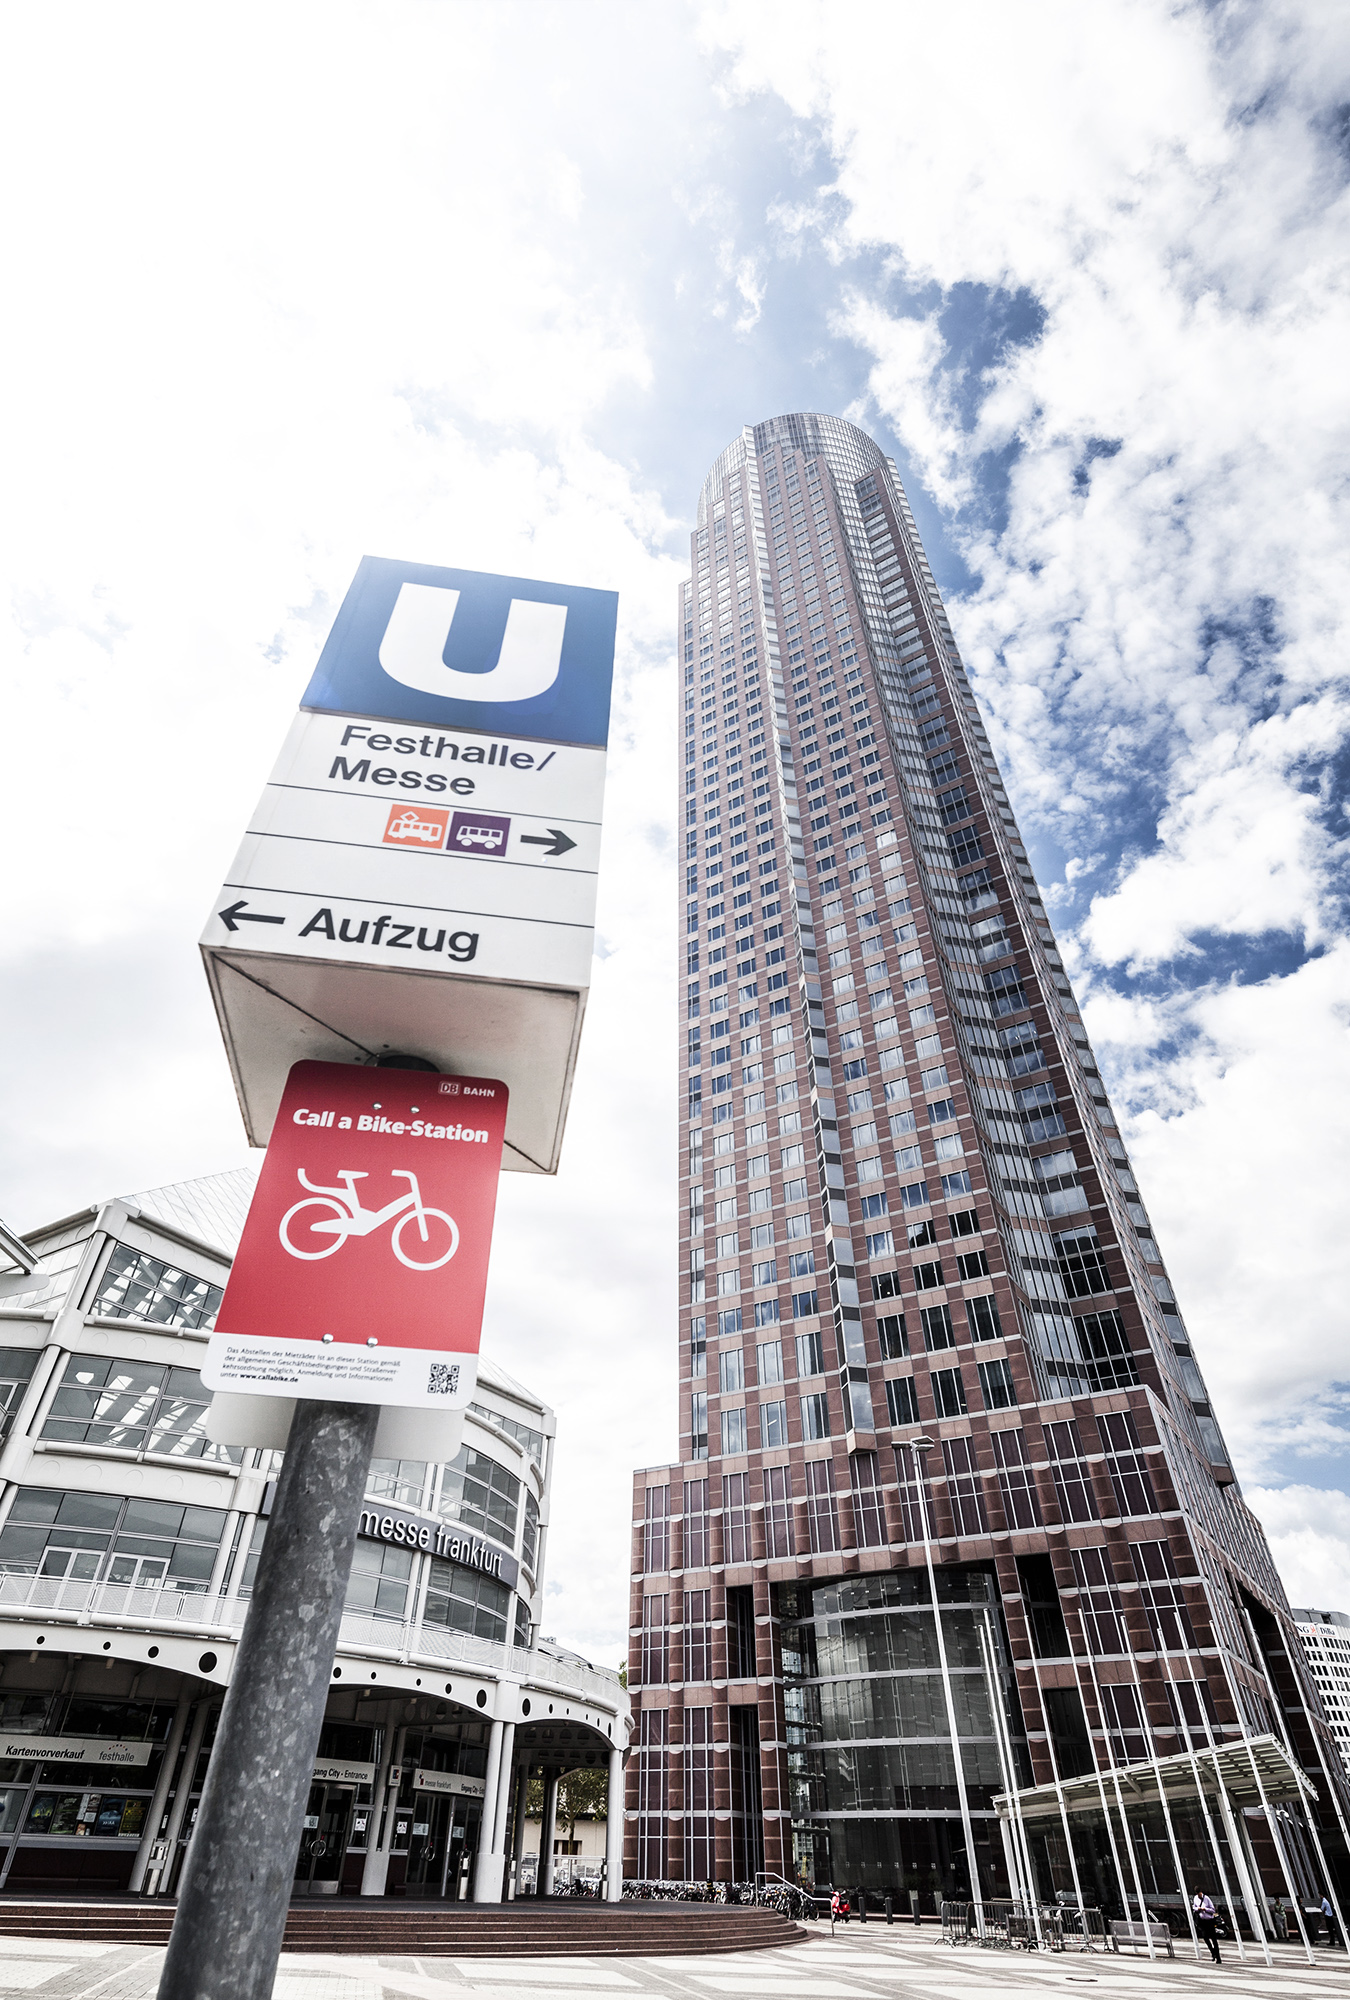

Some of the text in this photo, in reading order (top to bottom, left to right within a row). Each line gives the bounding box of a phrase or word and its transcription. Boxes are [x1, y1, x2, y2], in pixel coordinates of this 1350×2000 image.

[378, 581, 569, 703] U
[340, 724, 557, 772] Festhalle/
[328, 755, 476, 796] Messe
[297, 907, 480, 963] Aufzug
[440, 1082, 496, 1098] DB BAHN
[292, 1108, 489, 1144] Call a Bike-Station
[226, 1346, 239, 1354] Das
[240, 1348, 270, 1356] Abstellen
[285, 1352, 316, 1360] Mieträder
[357, 1357, 379, 1365] Station
[237, 1356, 276, 1365] allgemeinen
[277, 1359, 348, 1371] Geschäftsbedingungen
[222, 1363, 267, 1373] kehrsordnung
[268, 1367, 294, 1375] möglich.
[297, 1369, 333, 1378] Anmeldung
[348, 1373, 393, 1382] Informationen
[239, 1373, 299, 1383] www.callabike.de
[357, 1509, 503, 1577] messe frankfurt
[1296, 1625, 1310, 1634] NG
[5, 1745, 135, 1762] Kartenvorverkauf festhalle
[328, 1767, 341, 1779] City
[344, 1769, 368, 1780] Entrance
